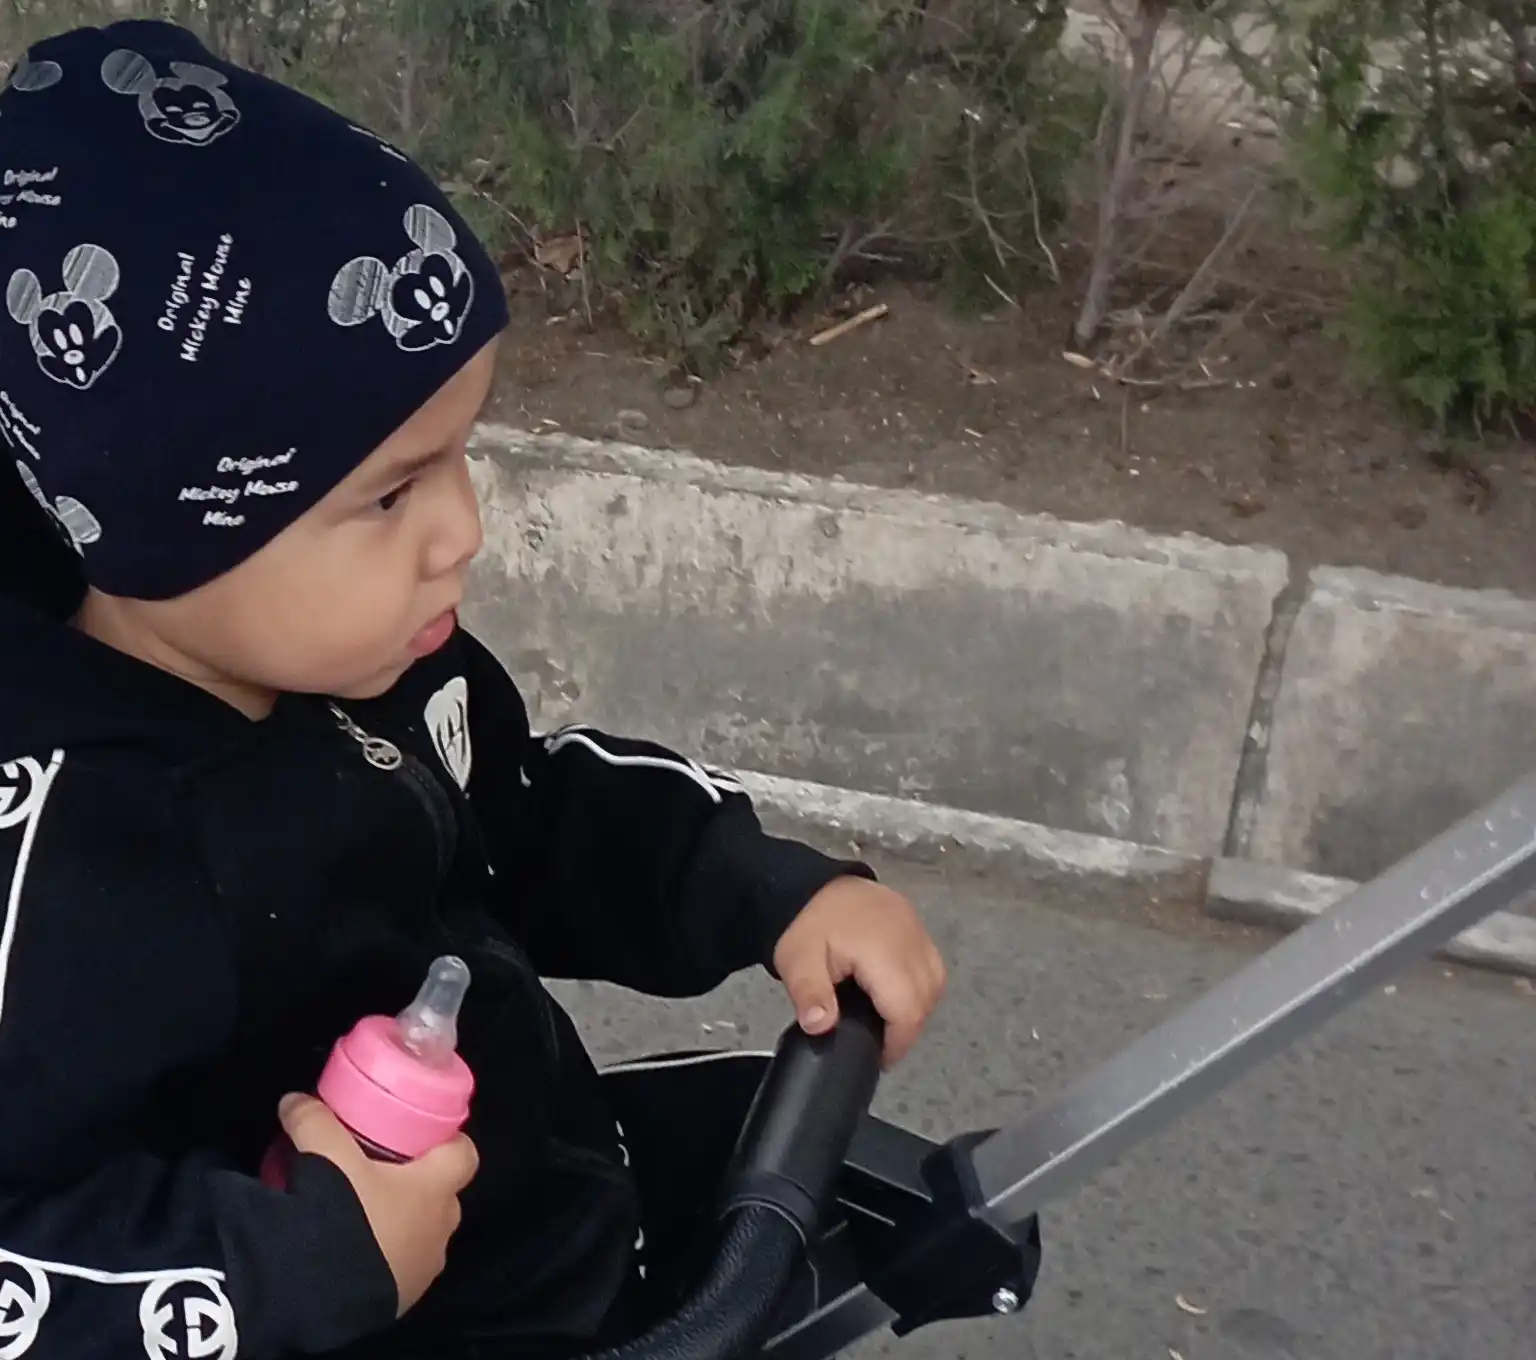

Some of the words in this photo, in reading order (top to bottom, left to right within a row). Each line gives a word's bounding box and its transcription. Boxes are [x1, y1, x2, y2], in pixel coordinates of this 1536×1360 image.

[157, 251, 196, 331] Original
[179, 295, 221, 362] Mickey
[200, 232, 234, 291] Mouse
[223, 277, 252, 325] Mine
[216, 447, 298, 476] Original
[202, 510, 246, 527] Mine
